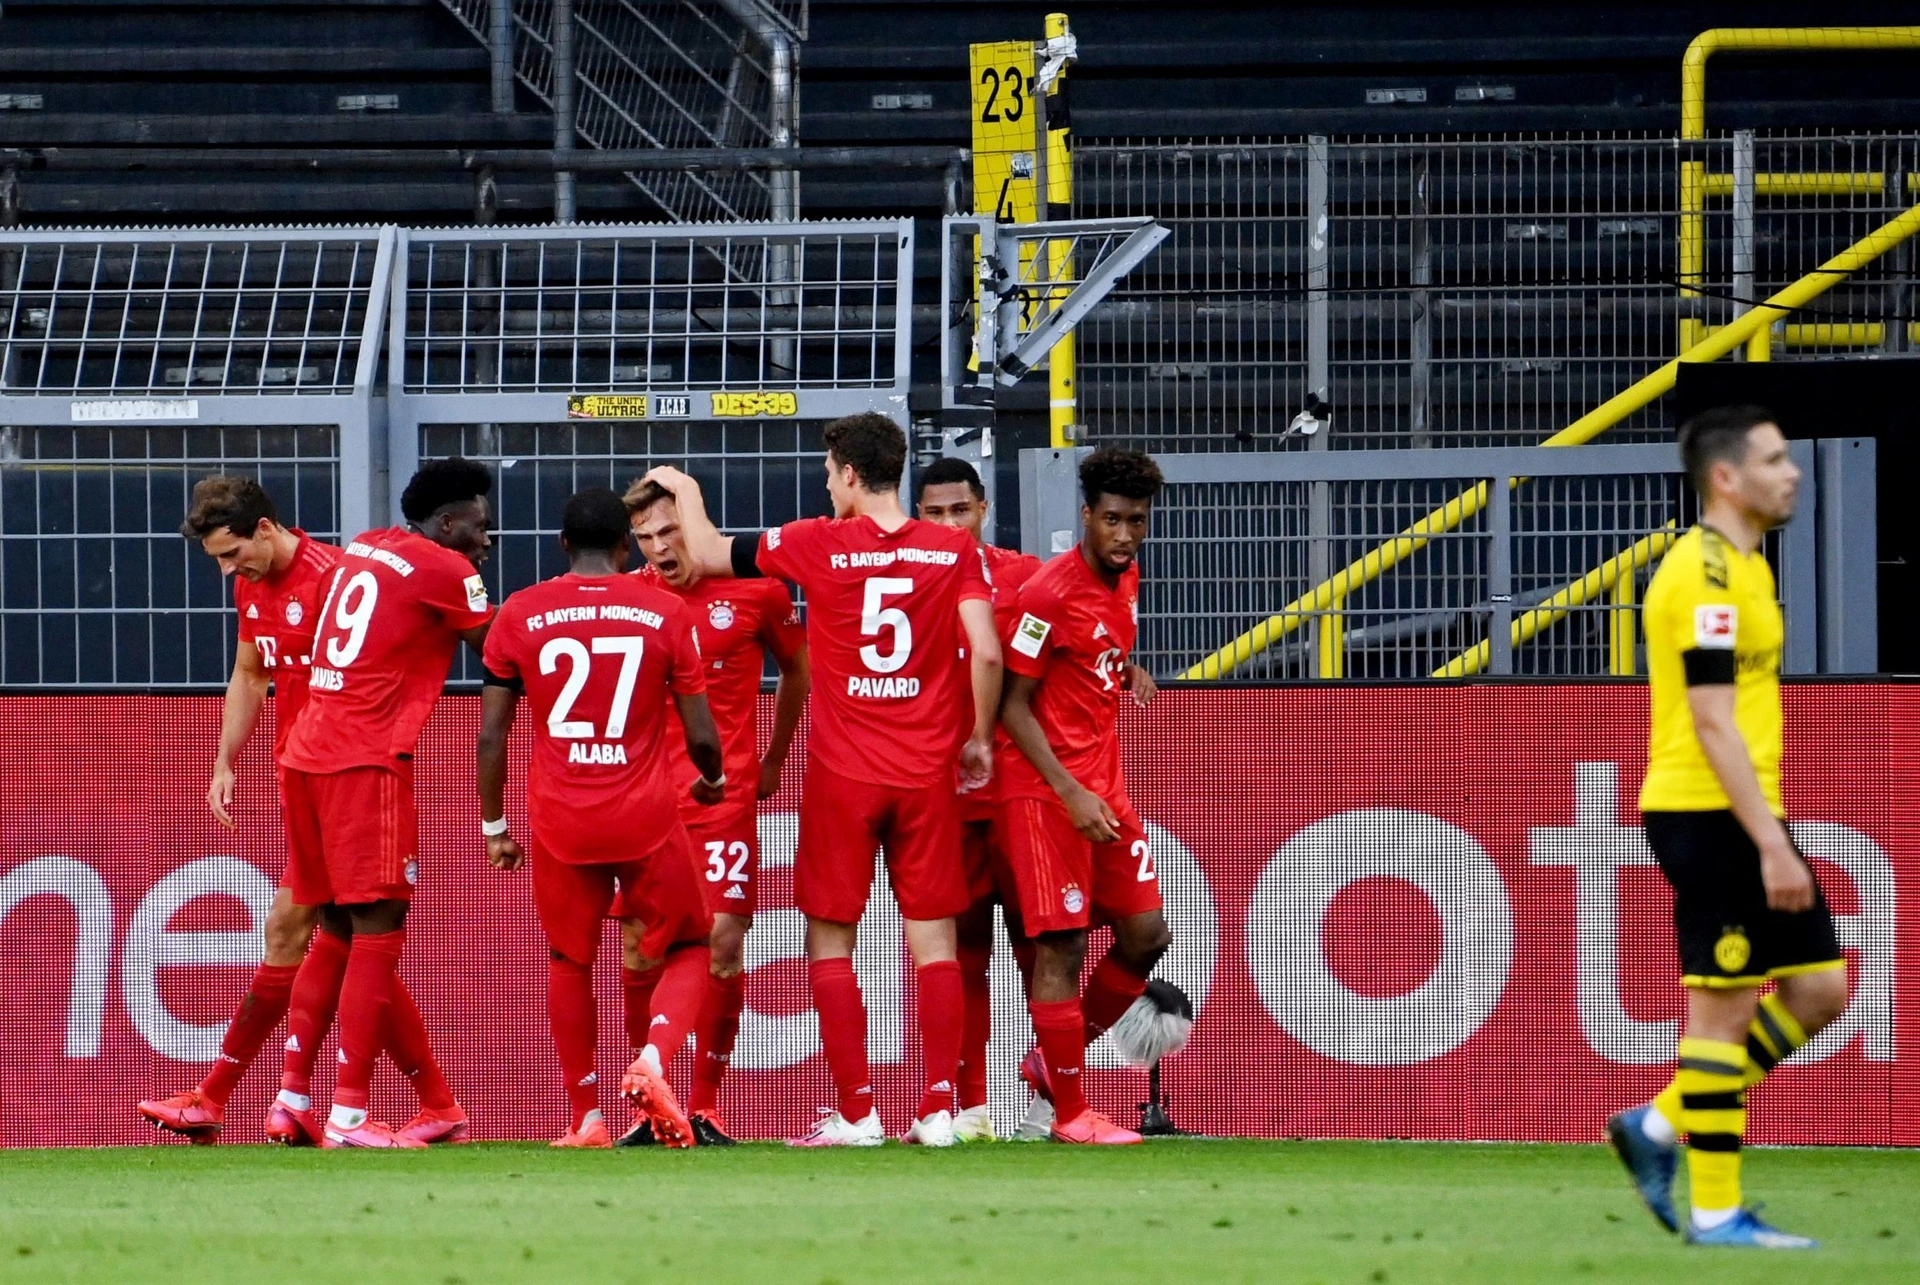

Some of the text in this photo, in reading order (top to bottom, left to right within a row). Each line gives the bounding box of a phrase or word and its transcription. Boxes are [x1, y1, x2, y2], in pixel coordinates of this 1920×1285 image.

[981, 66, 1024, 123] 23
[995, 178, 1016, 224] 4
[597, 396, 645, 405] THE UNITY
[597, 405, 646, 417] ULTRAS
[659, 398, 687, 415] ACAB
[830, 553, 848, 569] FC
[850, 550, 896, 568] BAYERN
[526, 614, 544, 632] FC
[545, 606, 597, 626] BAYERN
[859, 577, 914, 673] 5
[539, 636, 644, 738] 27
[847, 675, 921, 699] PAVARD
[568, 742, 628, 765] ALABA
[705, 840, 749, 882] 32
